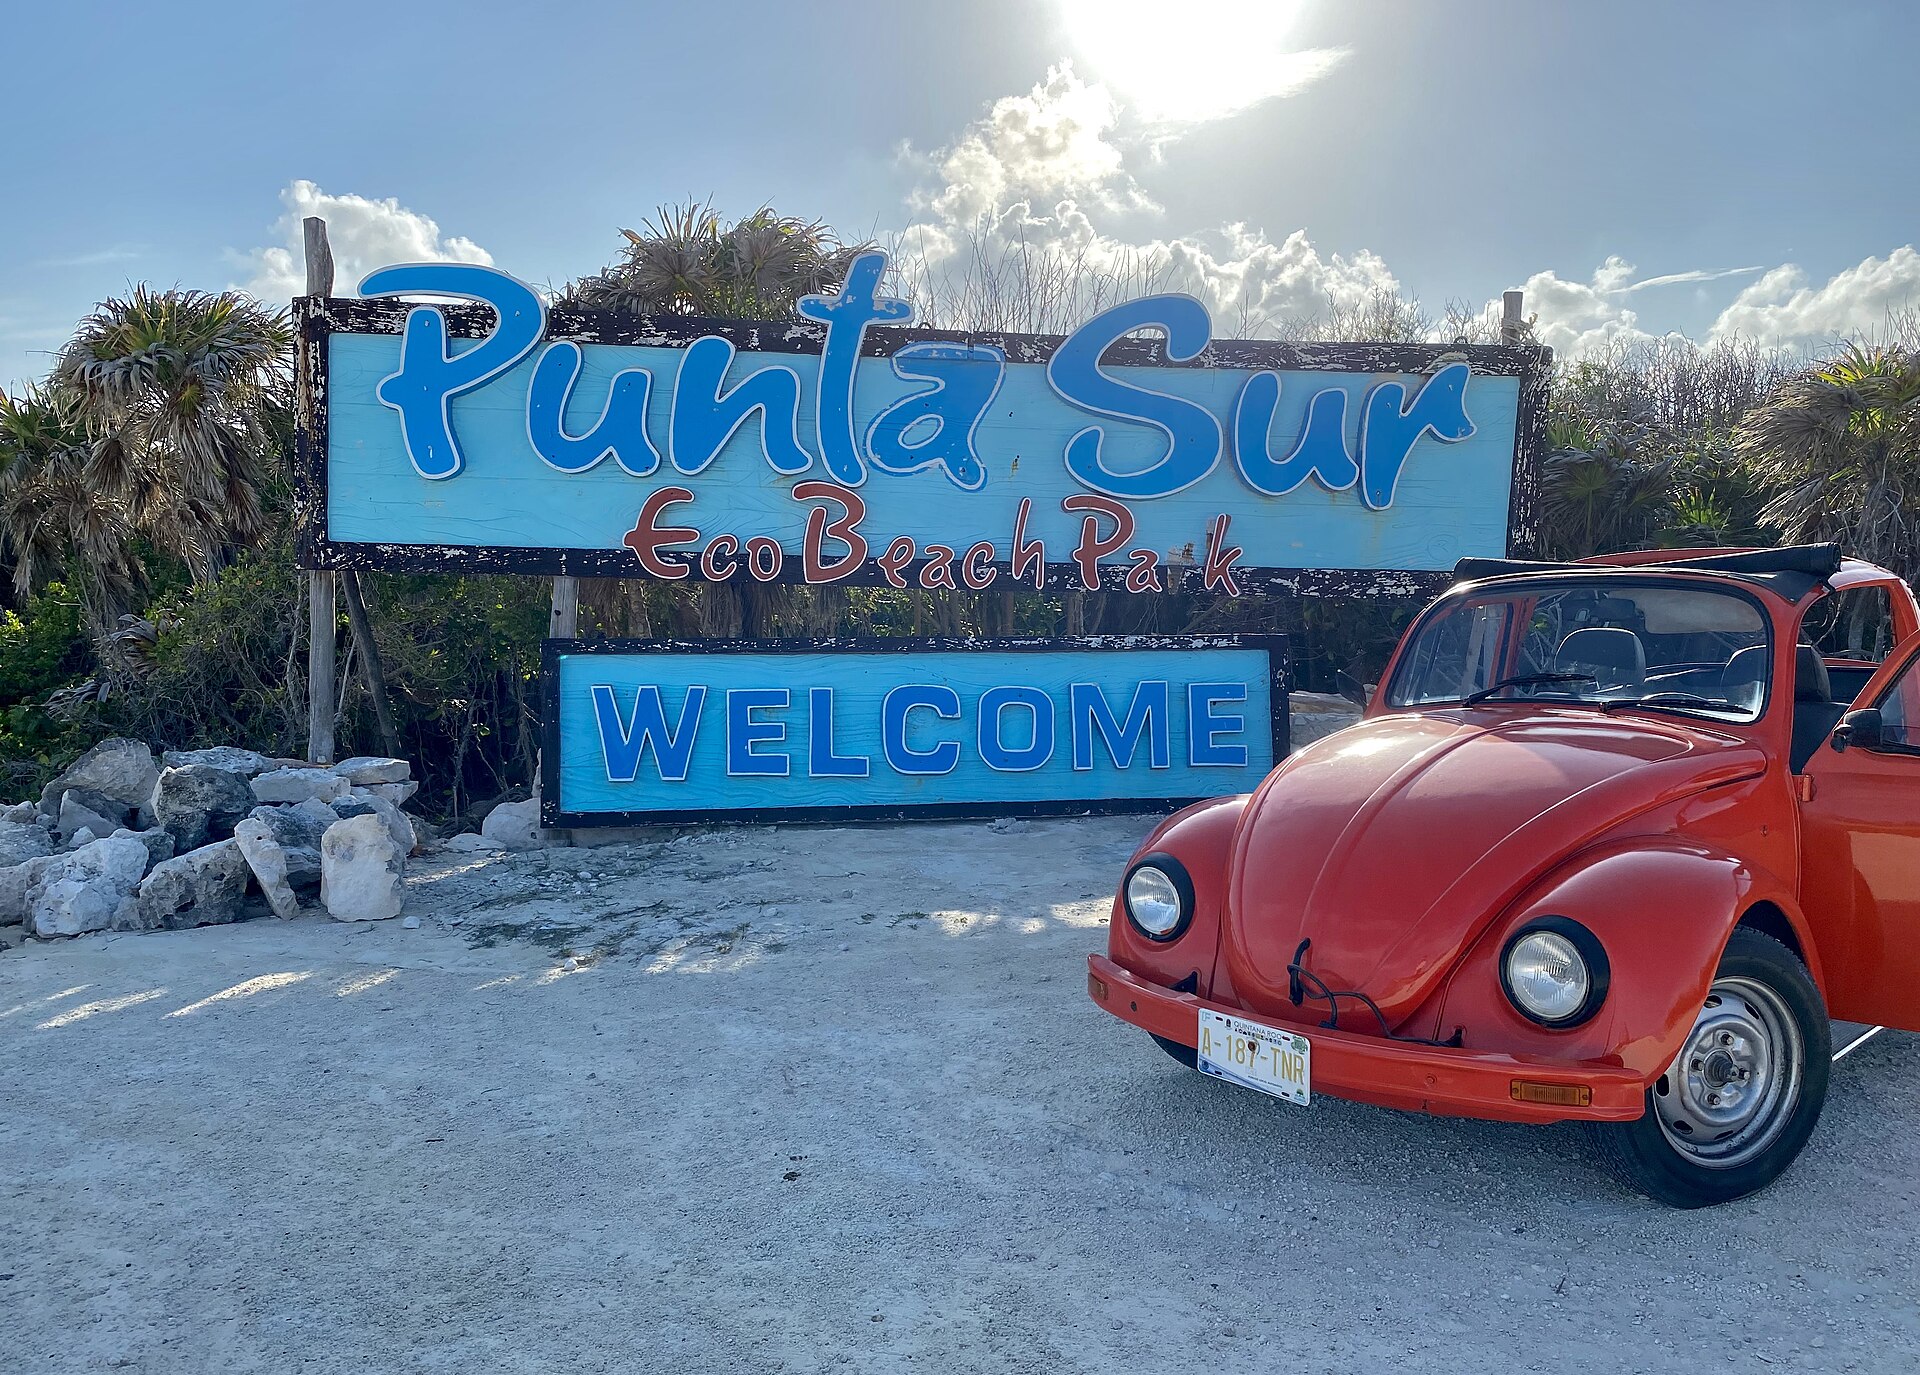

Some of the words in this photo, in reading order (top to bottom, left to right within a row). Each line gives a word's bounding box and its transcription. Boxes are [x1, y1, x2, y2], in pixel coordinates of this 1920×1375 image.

[357, 252, 1007, 490] Punta
[1045, 292, 1478, 511] Sur
[622, 486, 783, 581] Eco
[790, 481, 1045, 591] Beach
[1061, 493, 1244, 598] Pak
[590, 680, 1249, 783] WELCOME
[1233, 1020, 1266, 1035] QUINTANA
[1266, 1030, 1282, 1040] ROO
